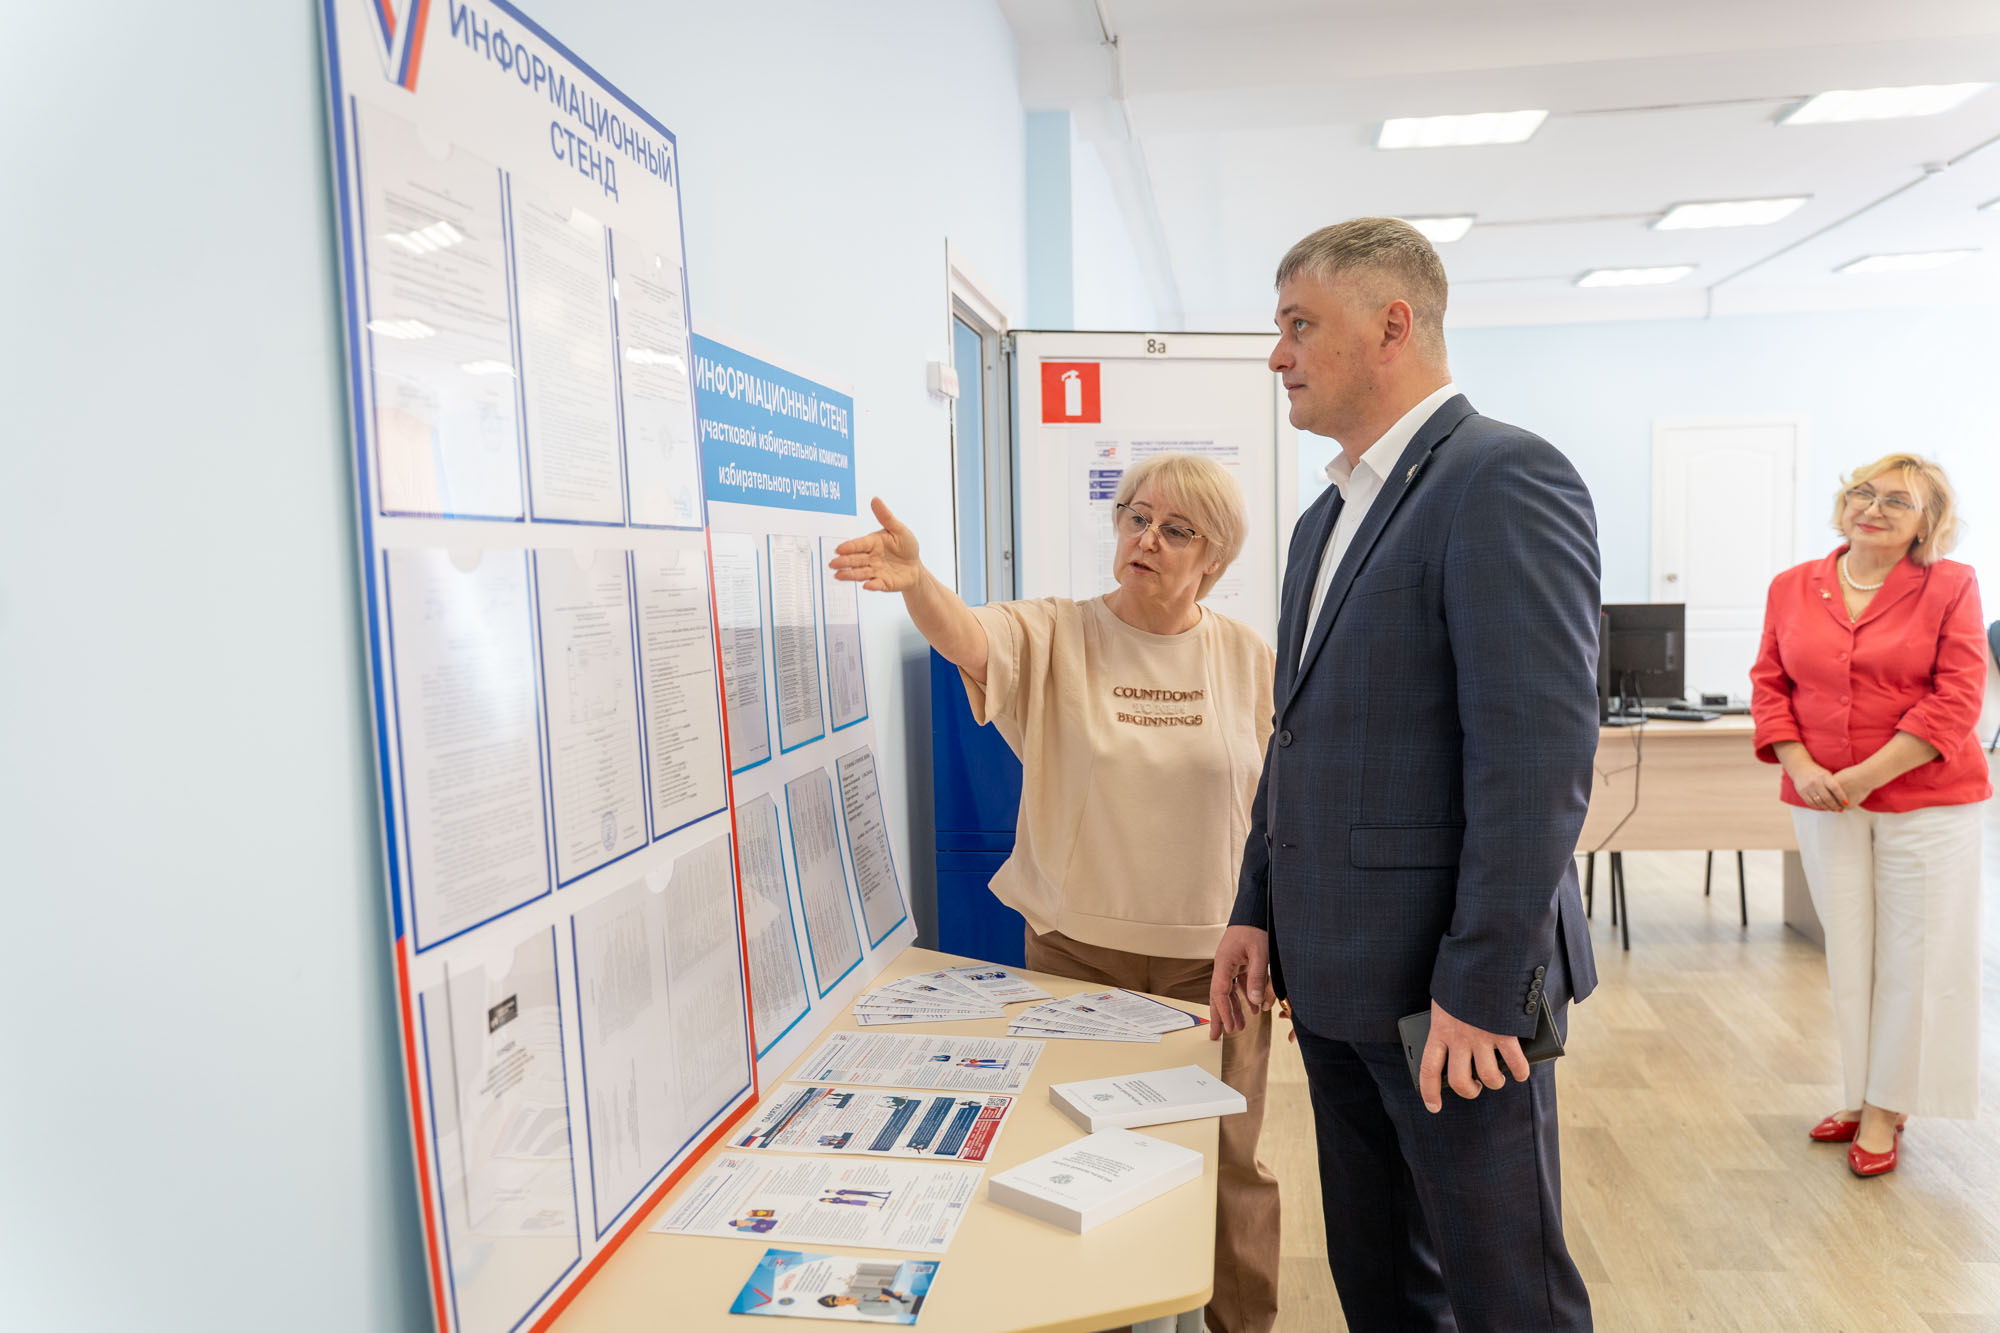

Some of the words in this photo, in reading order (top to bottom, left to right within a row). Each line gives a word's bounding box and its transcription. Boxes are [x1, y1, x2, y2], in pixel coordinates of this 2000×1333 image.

[449, 0, 673, 187] ИНФОРМАЦИОННЫЙ
[551, 120, 619, 203] СТЕНД
[695, 354, 818, 425] ИНФОРМАЦИОННЫЙ
[820, 400, 849, 440] СТЕНД
[700, 417, 757, 449] участковой
[759, 430, 818, 462] избирательной
[819, 447, 849, 470] комиссии
[719, 462, 791, 494] избирательного
[792, 477, 820, 500] участка
[820, 479, 829, 498] №
[1113, 687, 1204, 702] COUNTDOWN
[1117, 712, 1203, 727] BEGINNINGS
